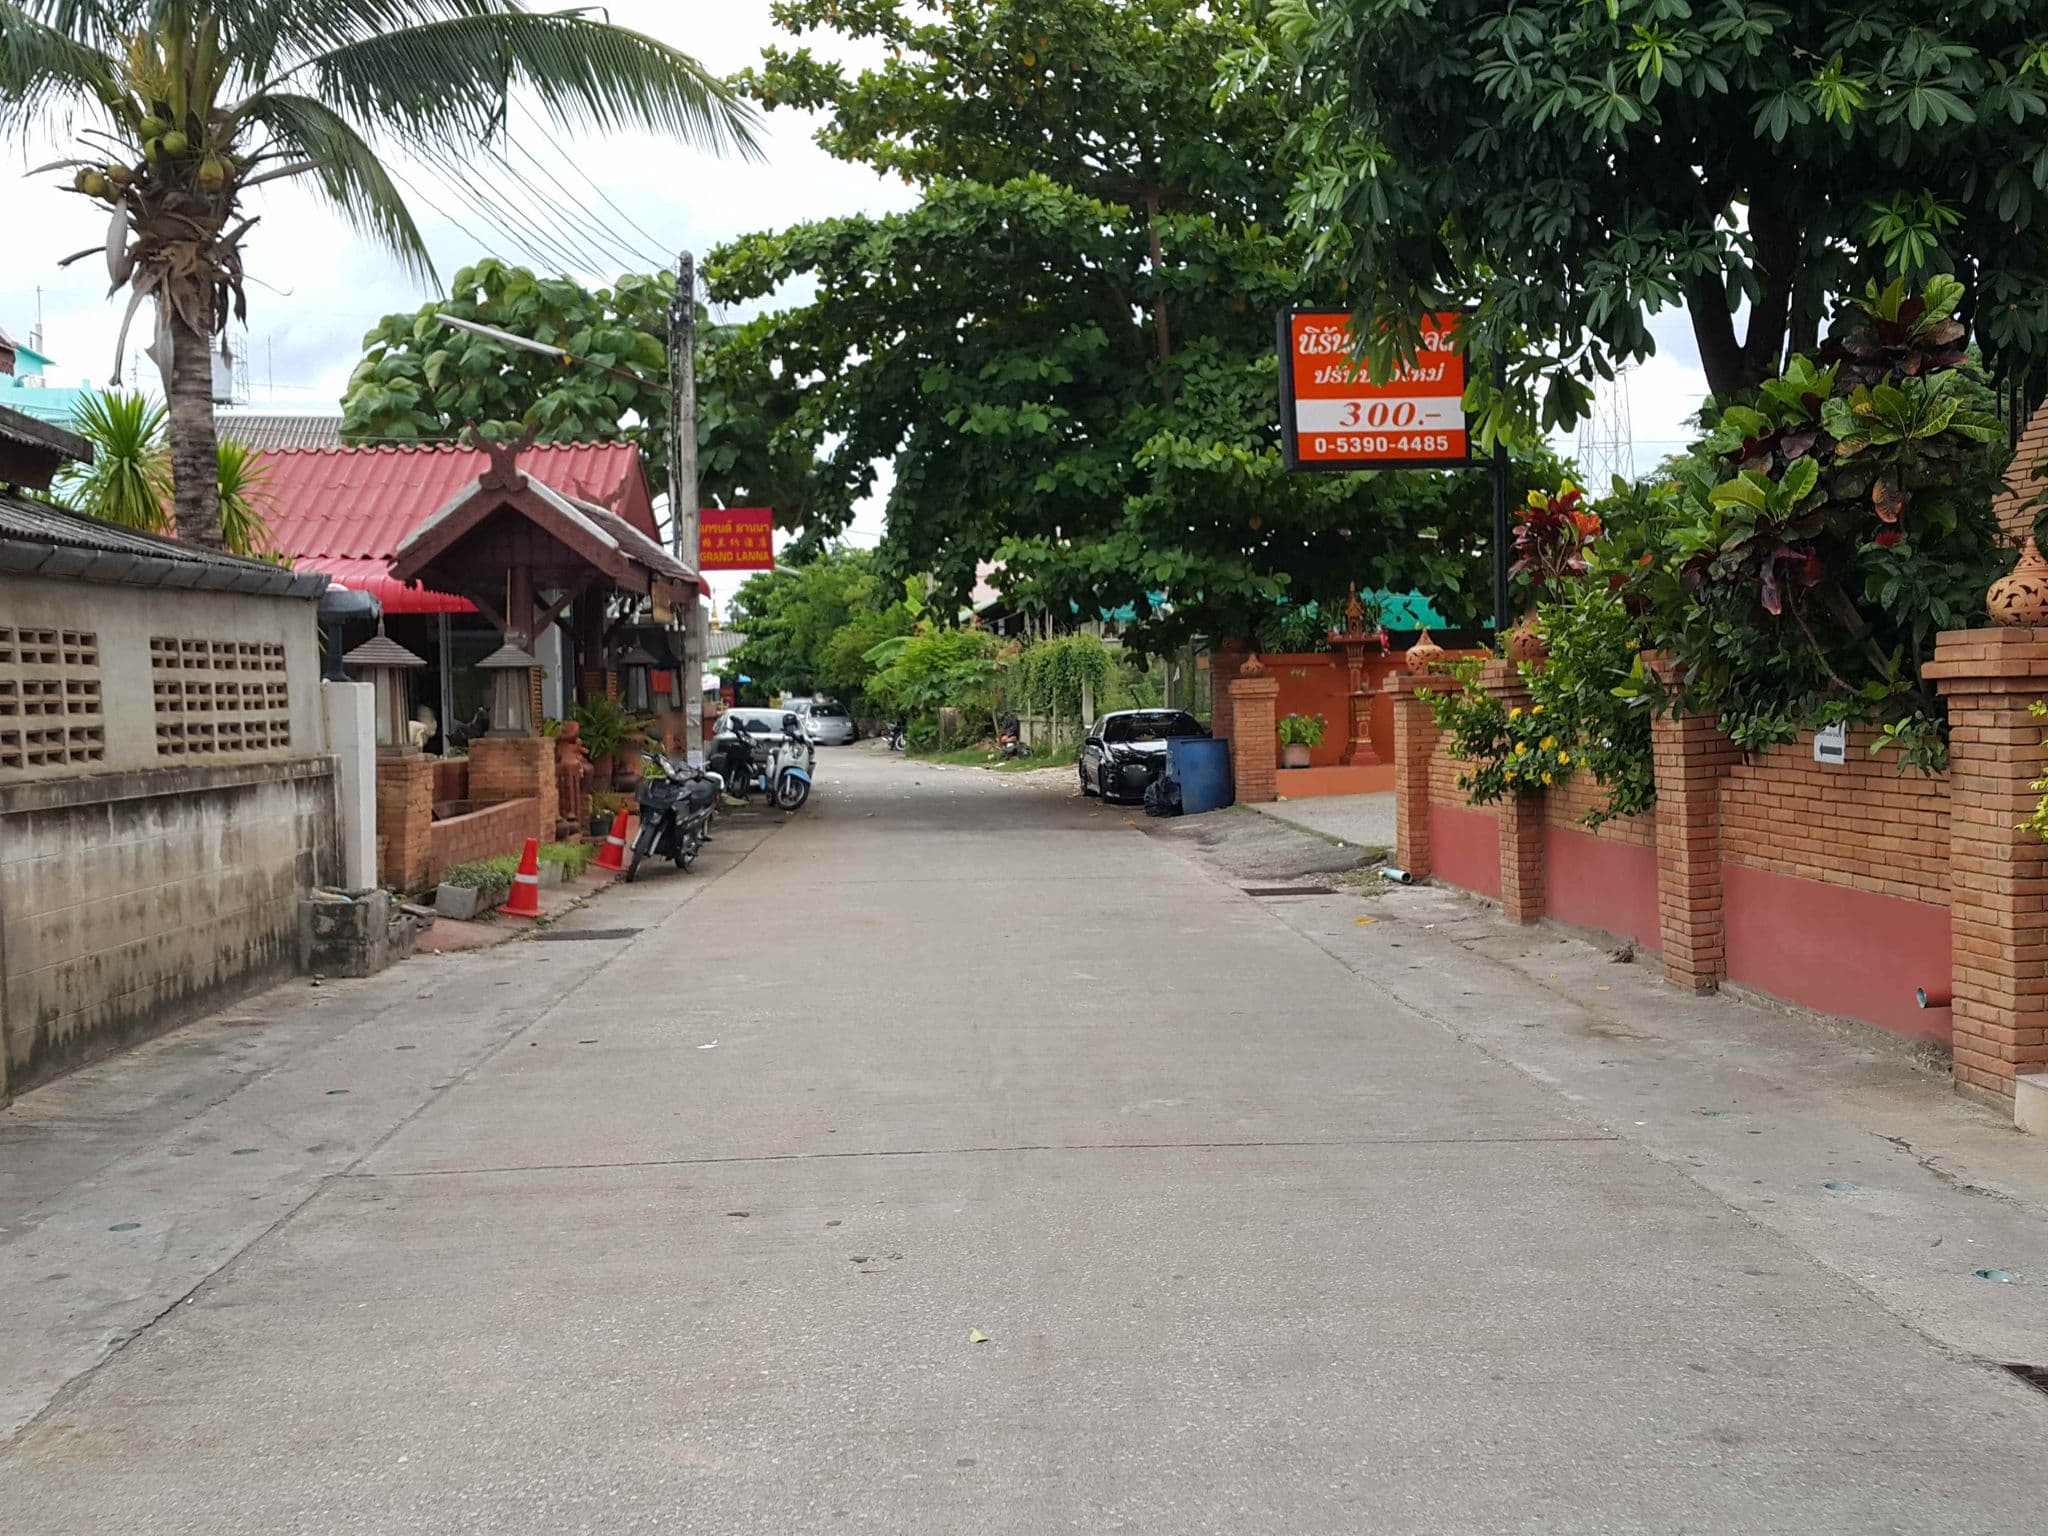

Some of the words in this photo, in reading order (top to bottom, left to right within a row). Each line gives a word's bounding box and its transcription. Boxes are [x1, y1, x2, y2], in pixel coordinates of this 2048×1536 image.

[1339, 402, 1441, 427] 300.-
[1314, 435, 1449, 454] 0-5390-4485
[700, 551, 733, 562] GRAND
[736, 551, 769, 561] LANNA
